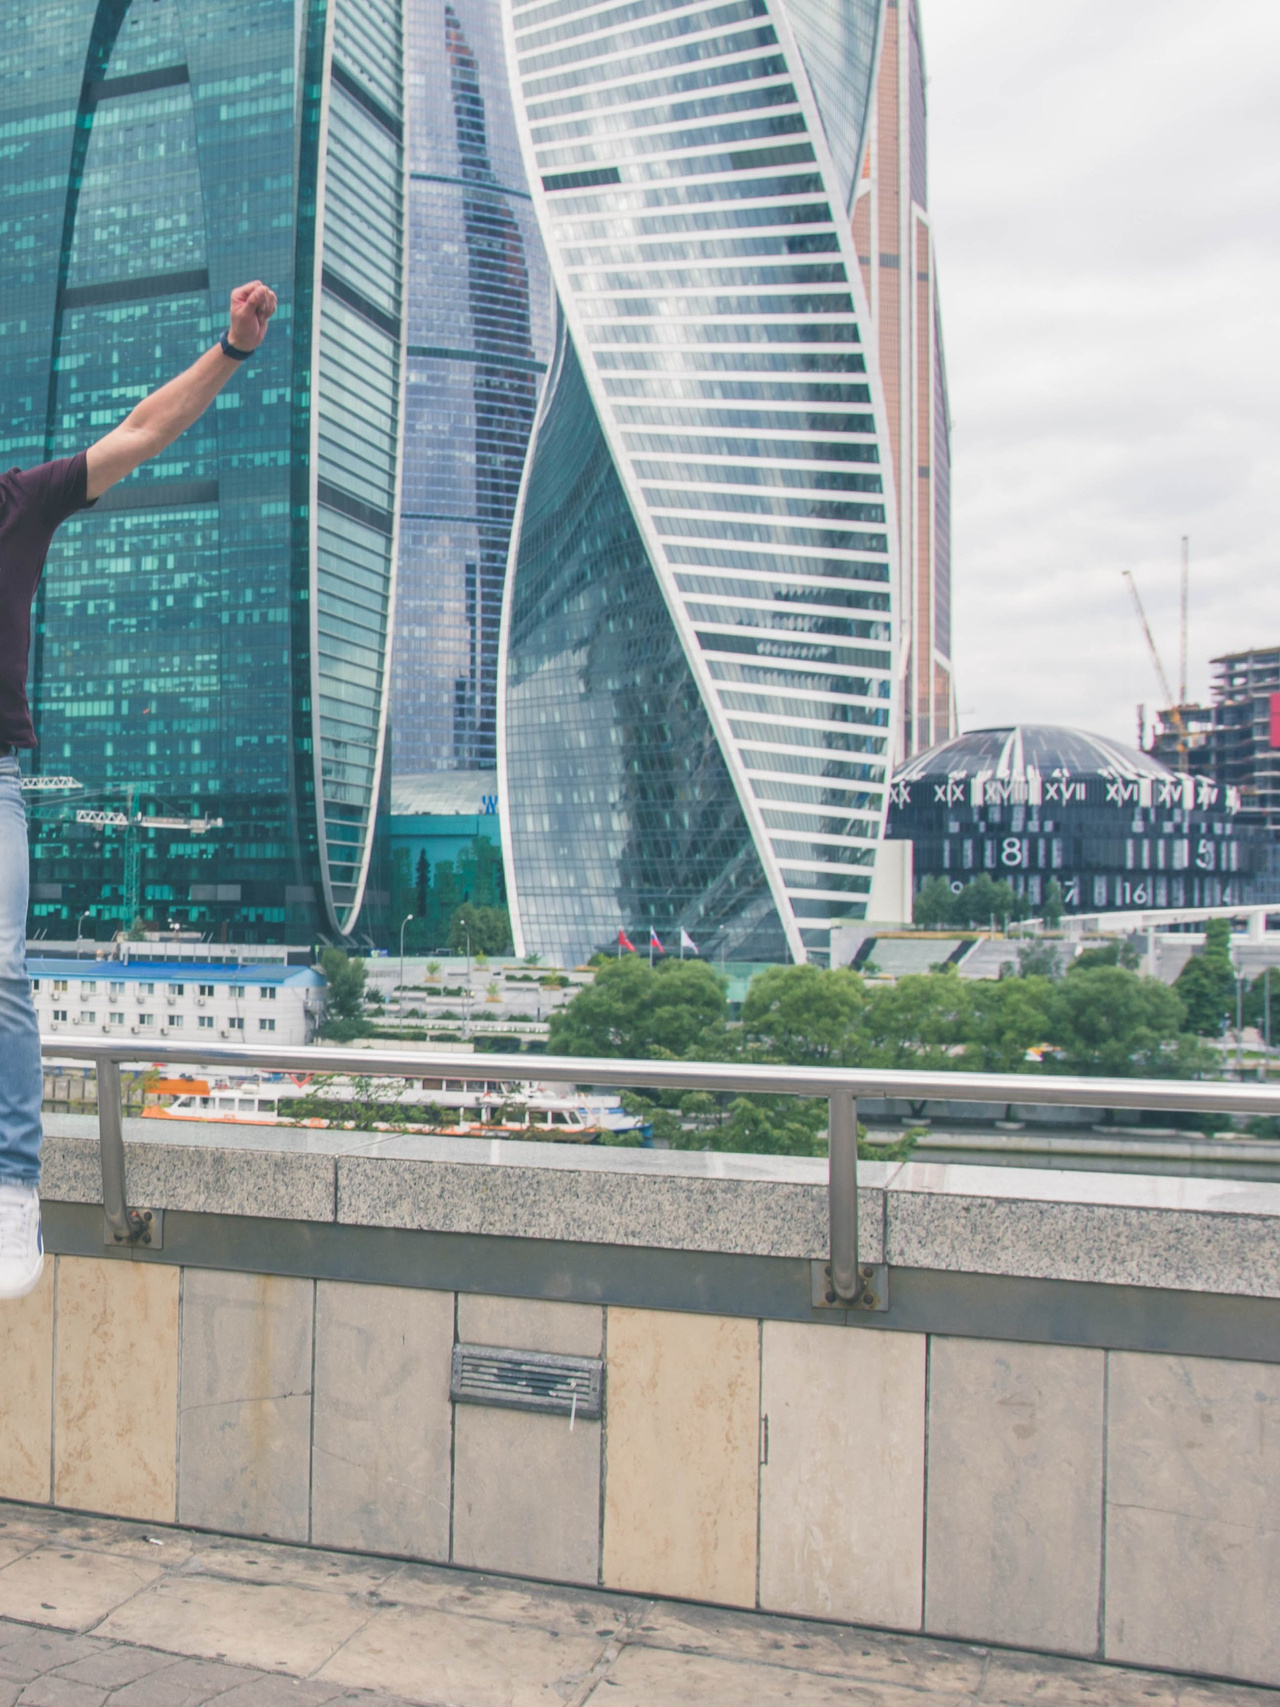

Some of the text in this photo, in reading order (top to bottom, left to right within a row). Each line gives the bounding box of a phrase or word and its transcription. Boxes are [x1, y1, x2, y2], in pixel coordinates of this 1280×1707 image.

[1045, 783, 1086, 802] XVII
[1106, 783, 1138, 802] XVI
[1001, 837, 1022, 866] 8
[1124, 881, 1147, 904] 16
